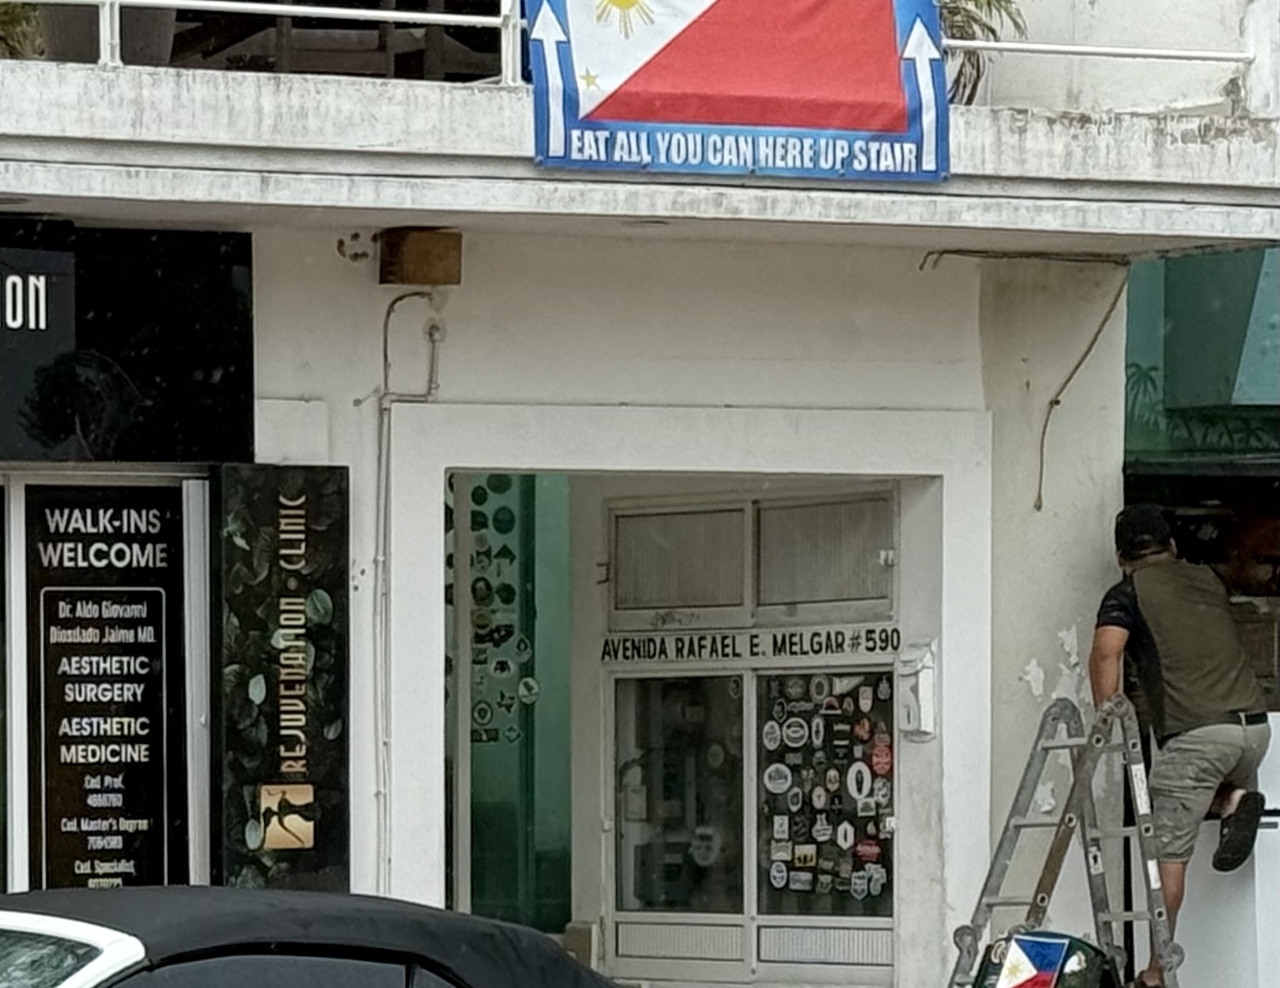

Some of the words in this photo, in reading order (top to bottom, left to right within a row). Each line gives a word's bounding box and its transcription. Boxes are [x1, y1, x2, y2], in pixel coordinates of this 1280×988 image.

[570, 129, 610, 161] EAT
[613, 130, 652, 164] ALL
[656, 132, 703, 165] YOU
[707, 134, 754, 168] CAN
[757, 136, 814, 169] HERE
[819, 138, 850, 170] UP
[853, 140, 917, 173] STAIR
[45, 508, 161, 534] WALK-INS
[278, 494, 307, 571] CLINIC
[38, 542, 168, 568] WELCOME
[75, 600, 100, 619] Aldo
[600, 637, 669, 662] AVENIDA
[674, 635, 742, 660] RAFAEL
[749, 633, 767, 658] E.
[772, 630, 846, 657] MELGAR
[57, 656, 150, 676] AESTHETIC
[64, 682, 145, 702] SURGERY
[279, 596, 308, 775] REJUVENATION
[58, 717, 150, 736] AESTHETIC
[60, 744, 150, 763] MEDICINE
